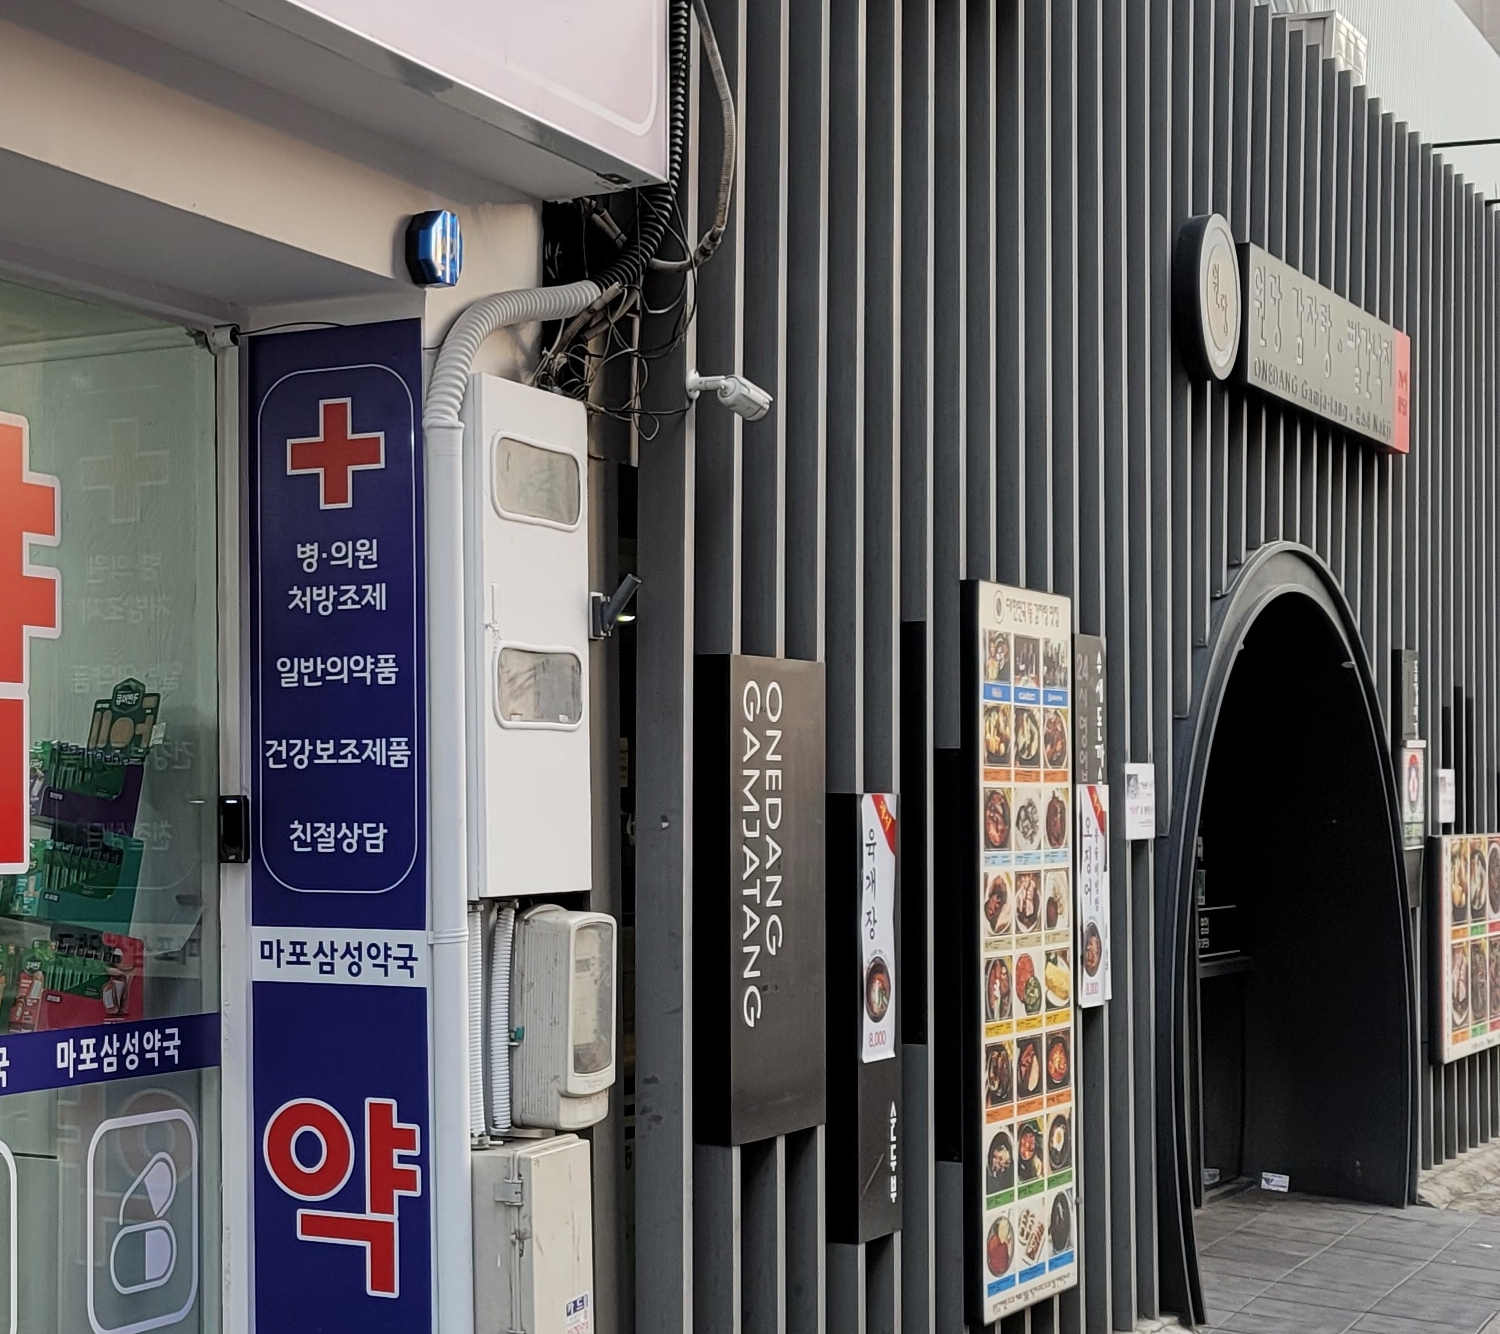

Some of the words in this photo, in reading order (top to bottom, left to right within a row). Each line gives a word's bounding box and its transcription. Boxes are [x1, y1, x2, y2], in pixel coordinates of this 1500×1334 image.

[1254, 266, 1282, 354] 원당
[1293, 287, 1333, 378] 감자탕
[1253, 357, 1298, 396] ONEDANG
[296, 539, 379, 572] 병·의원
[287, 584, 388, 614] 처방조제
[275, 655, 399, 686] 일반의약품
[264, 737, 412, 770] 건강보조제품
[288, 820, 389, 854] 친절상담
[765, 680, 784, 957] ONEDANG
[741, 680, 764, 1029] GAMJATANG
[1083, 816, 1093, 907] 오징어
[865, 828, 878, 941] 육개장
[259, 938, 419, 979] 마포삼성약국
[55, 1028, 181, 1078] 마포삼성약국
[868, 1030, 887, 1049] 8,000
[263, 1098, 421, 1299] 약
